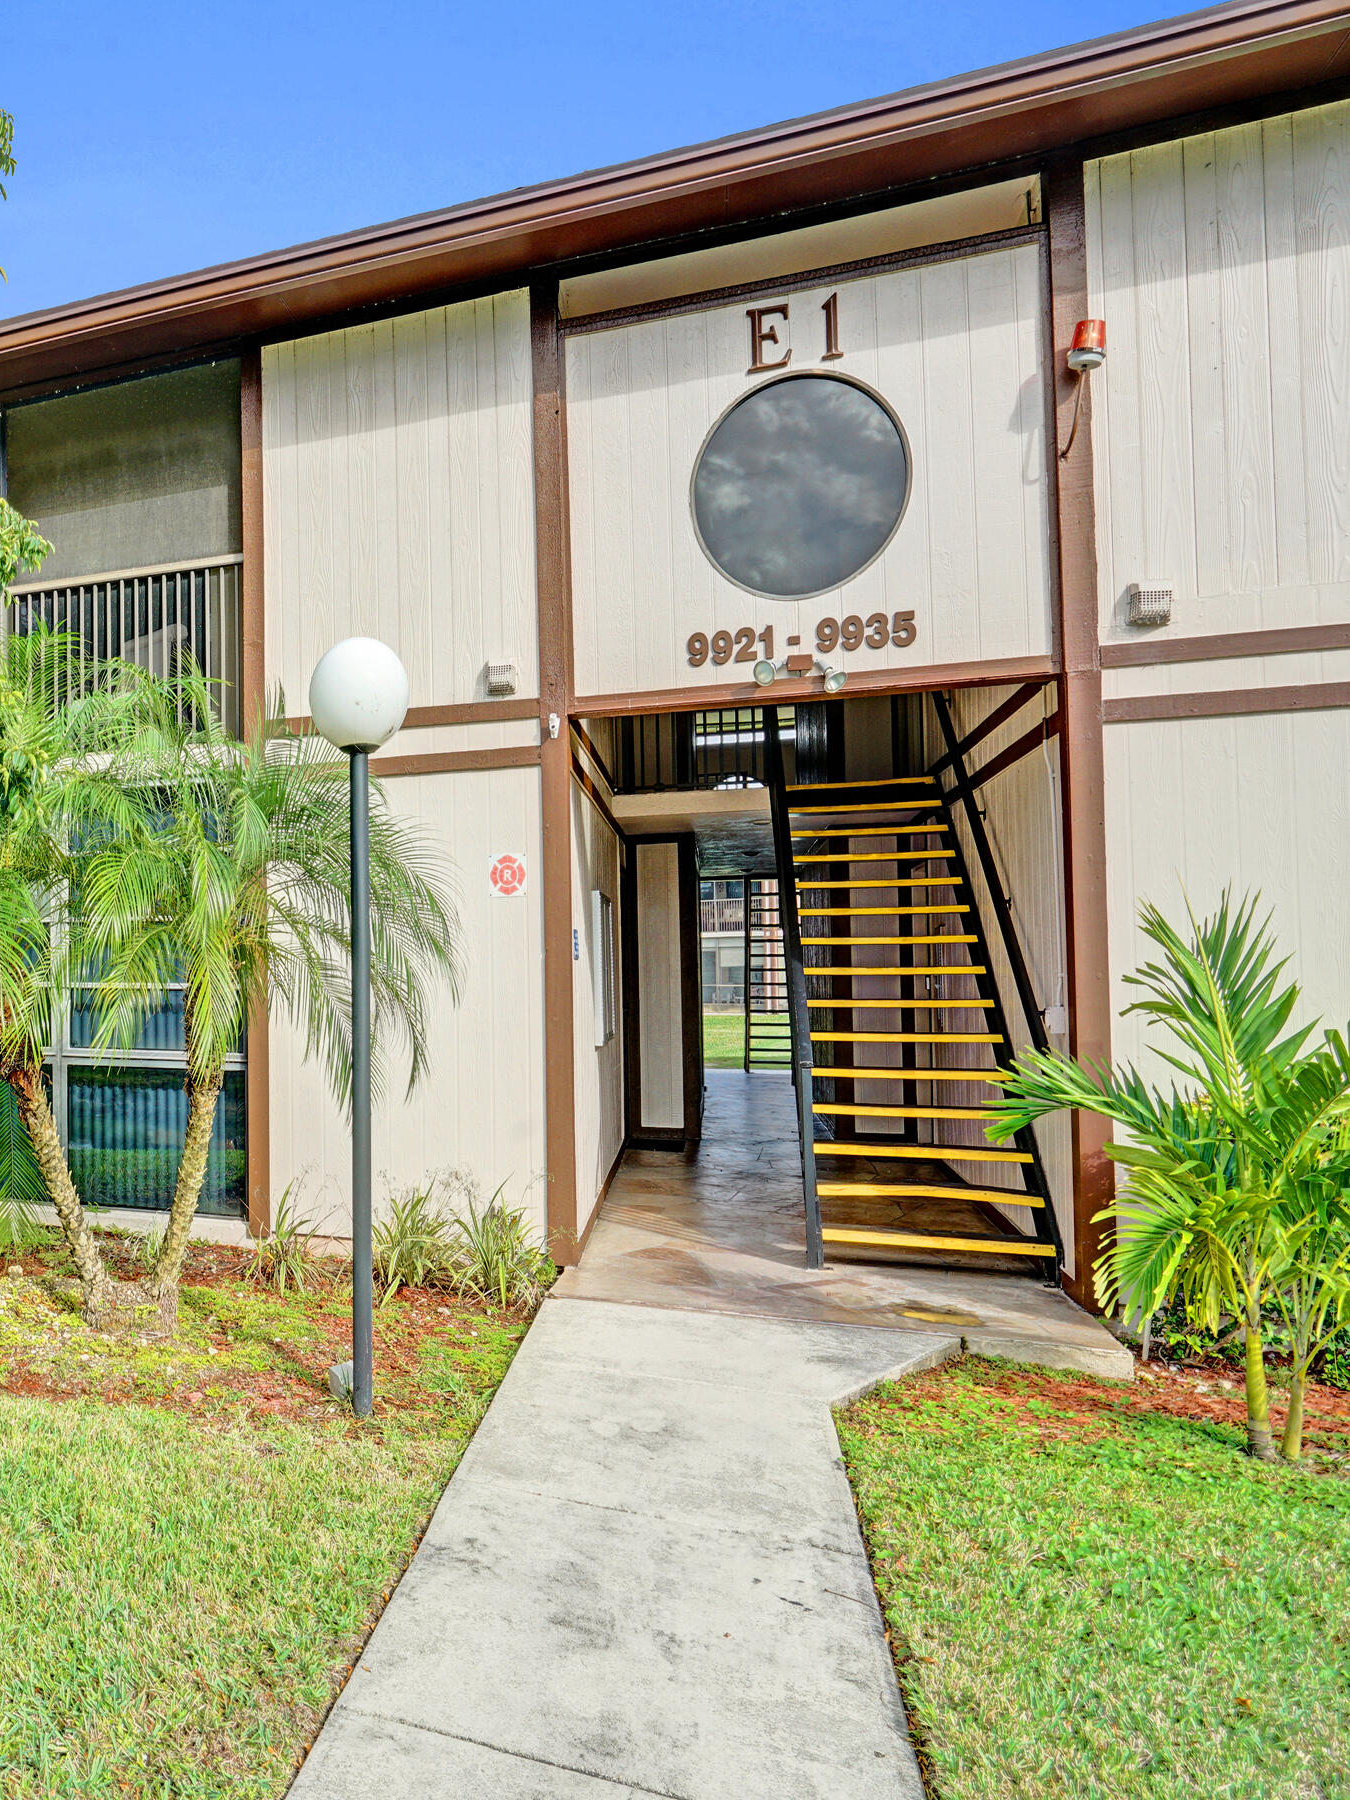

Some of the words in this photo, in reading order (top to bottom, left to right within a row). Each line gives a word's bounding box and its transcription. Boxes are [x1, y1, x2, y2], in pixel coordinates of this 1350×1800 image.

[746, 303, 792, 374] E
[821, 292, 844, 361] 1
[687, 625, 774, 667] 9921
[816, 610, 917, 653] 9935
[503, 869, 513, 881] R
